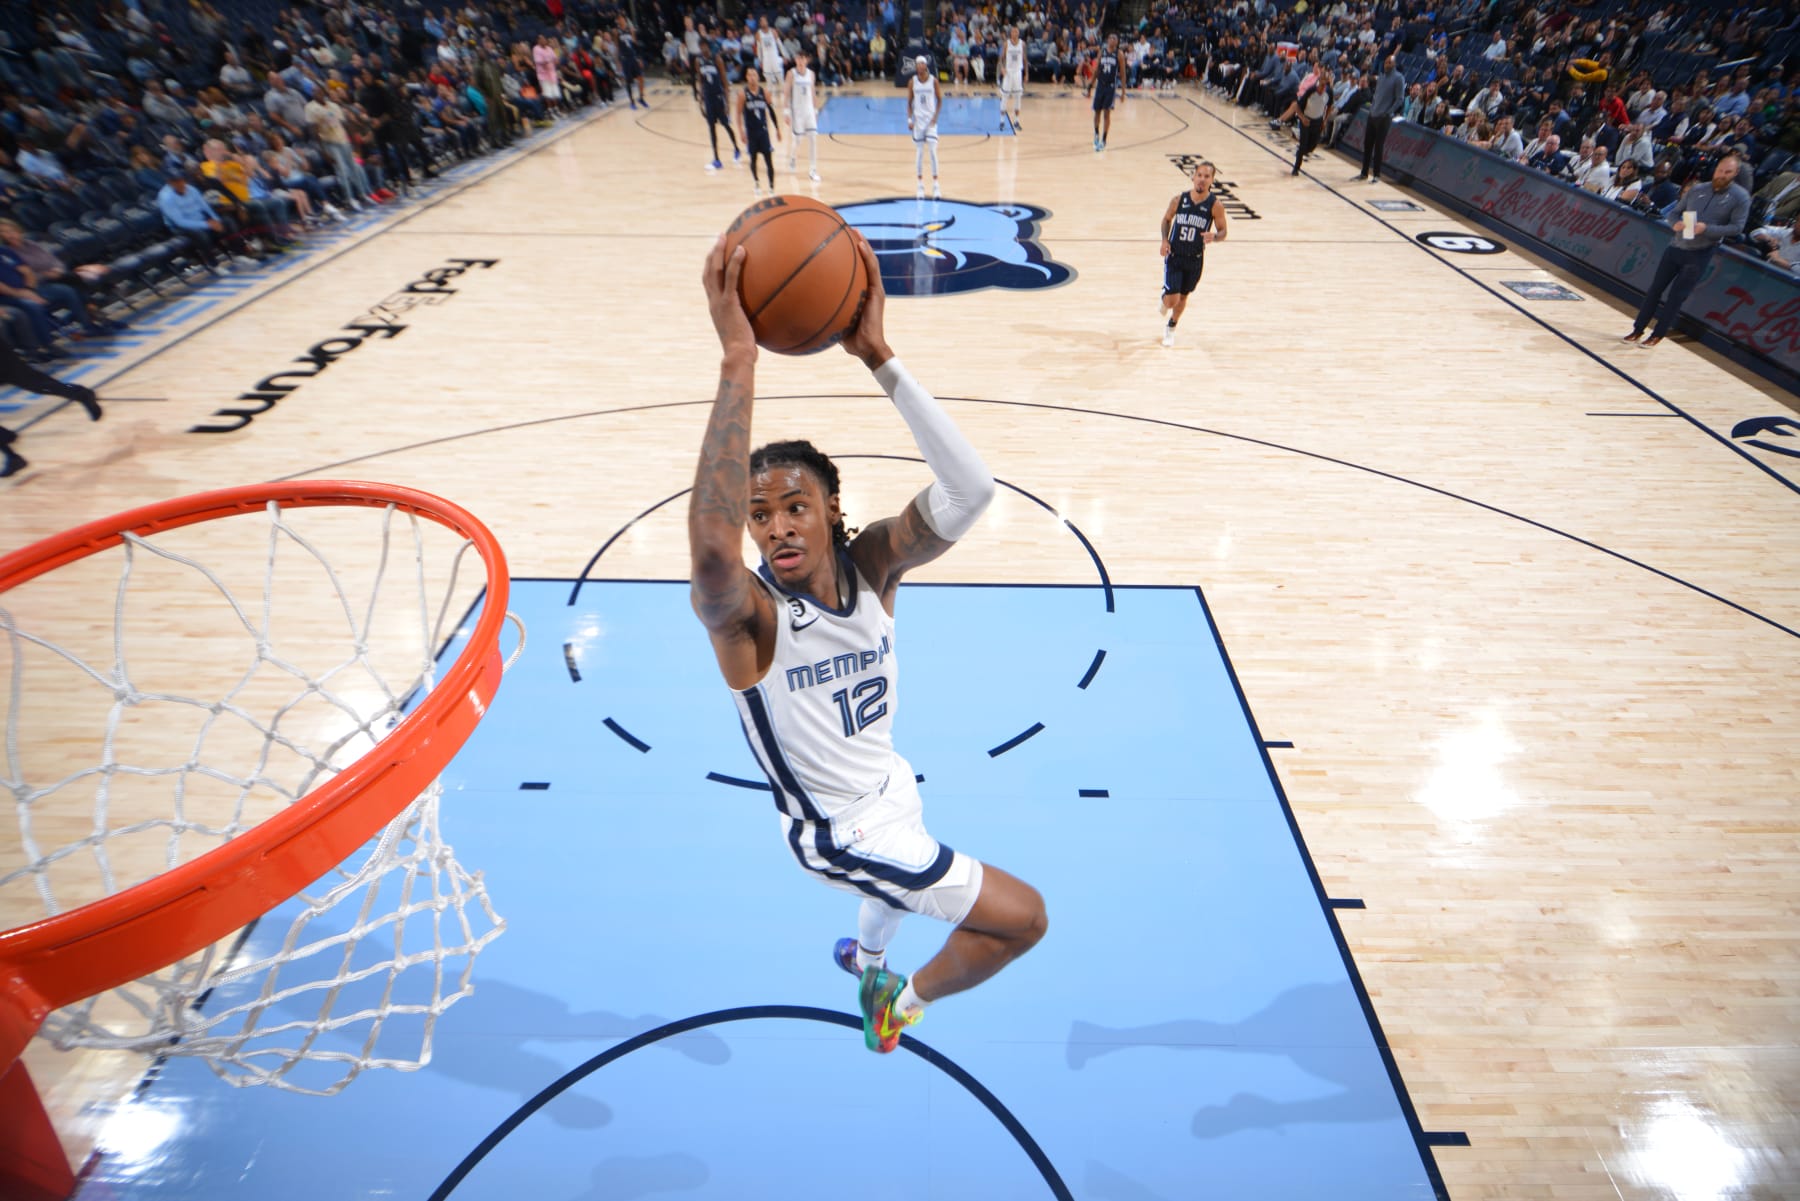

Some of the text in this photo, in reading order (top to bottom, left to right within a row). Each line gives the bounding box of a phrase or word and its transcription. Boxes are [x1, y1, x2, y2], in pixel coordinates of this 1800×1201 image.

[1176, 213, 1207, 229] ORLANDO
[1481, 174, 1541, 220] Love
[1530, 189, 1629, 243] Memphis
[1179, 227, 1196, 242] 50
[832, 675, 888, 738] 12
